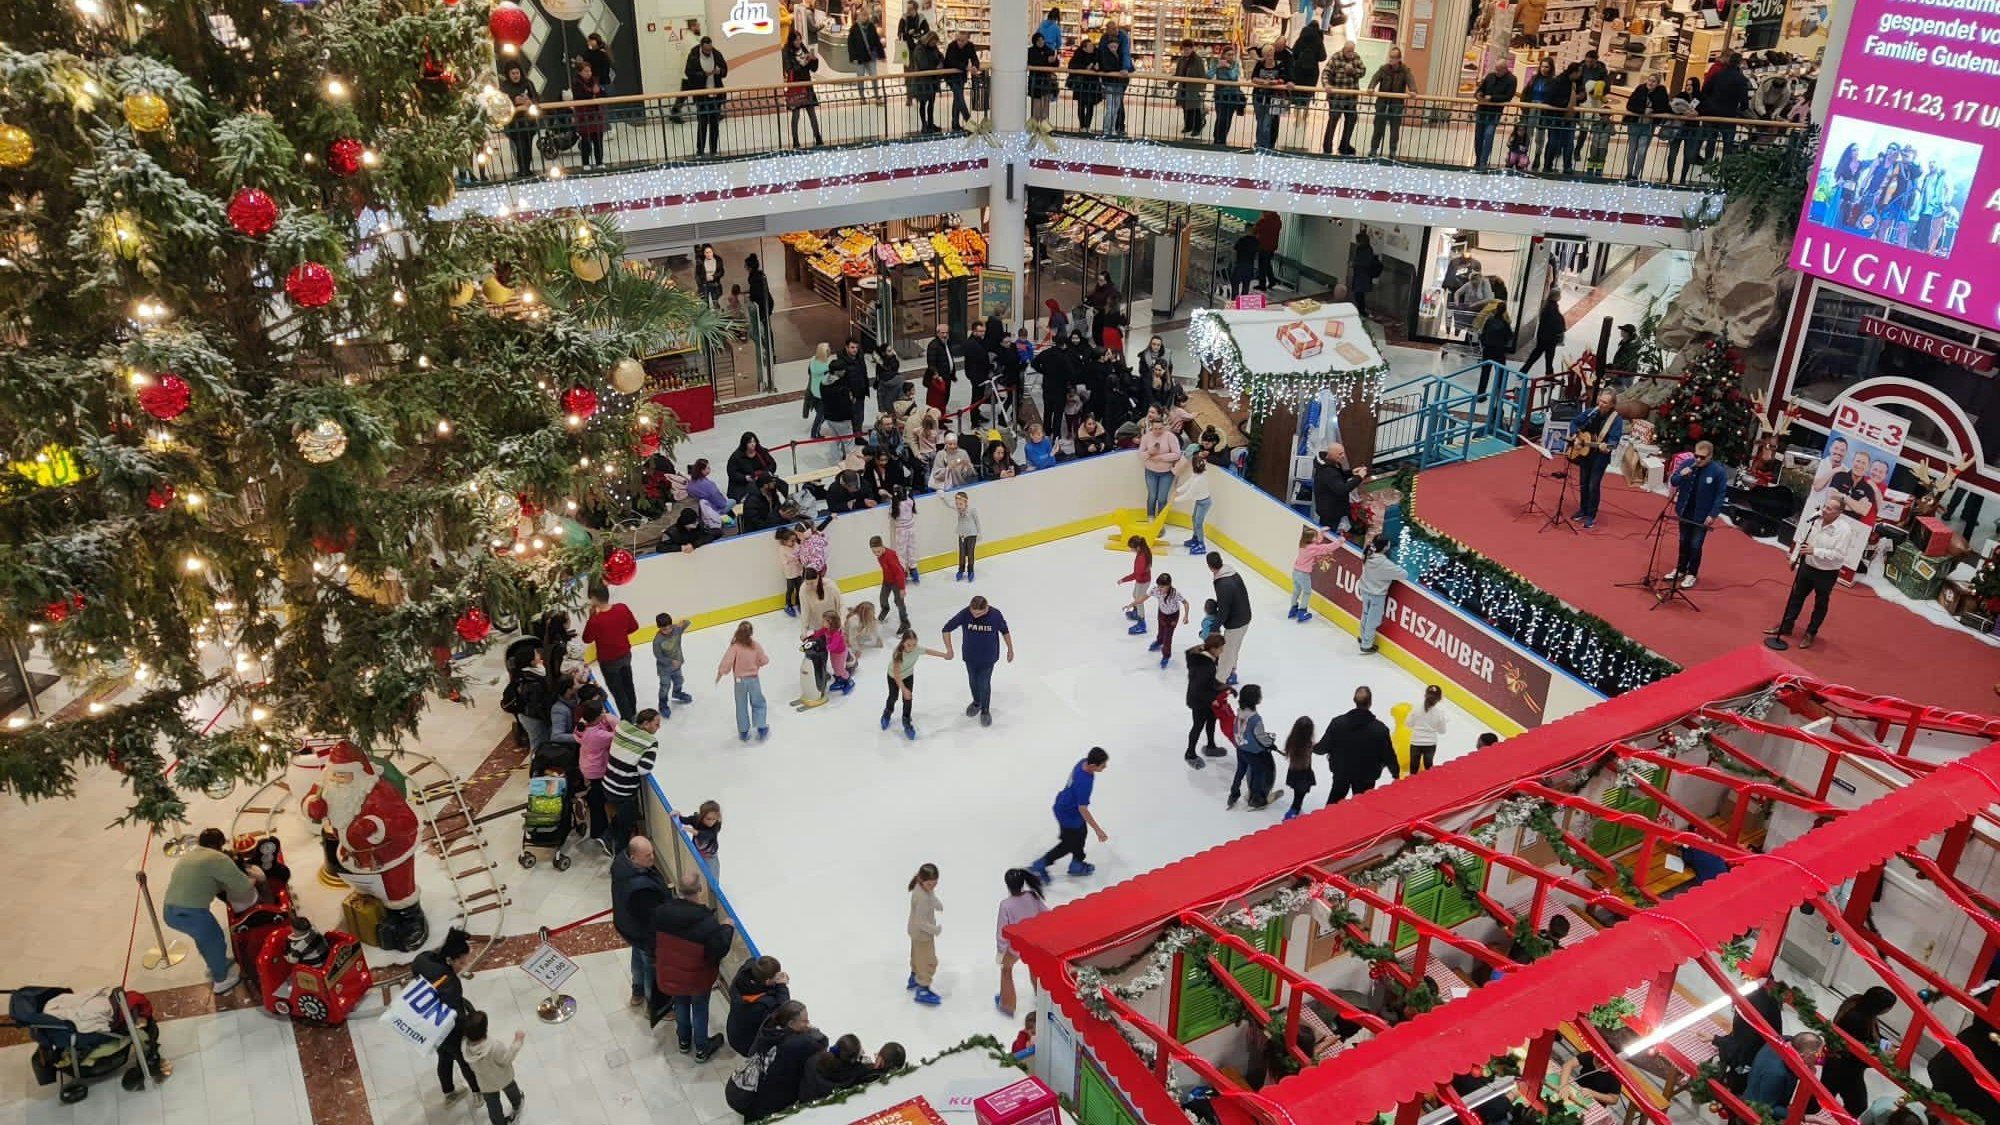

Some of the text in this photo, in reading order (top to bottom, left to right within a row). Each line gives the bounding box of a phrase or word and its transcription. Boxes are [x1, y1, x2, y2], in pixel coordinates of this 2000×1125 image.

[733, 1, 765, 20] dm
[1752, 0, 1784, 18] 50%
[1879, 13, 1978, 41] gespendet
[1864, 35, 1928, 63] Familie
[1838, 78, 1859, 101] Fr.
[1864, 83, 1946, 121] 17.11.23,
[1952, 99, 1979, 122] 17
[1800, 237, 1972, 315] LUGNER
[1865, 319, 1984, 366] LUGNER CITY
[1883, 424, 1903, 446] 3
[967, 623, 992, 632] PARIS
[1400, 605, 1495, 684] EISZAUBER
[393, 1018, 428, 1045] ACTION
